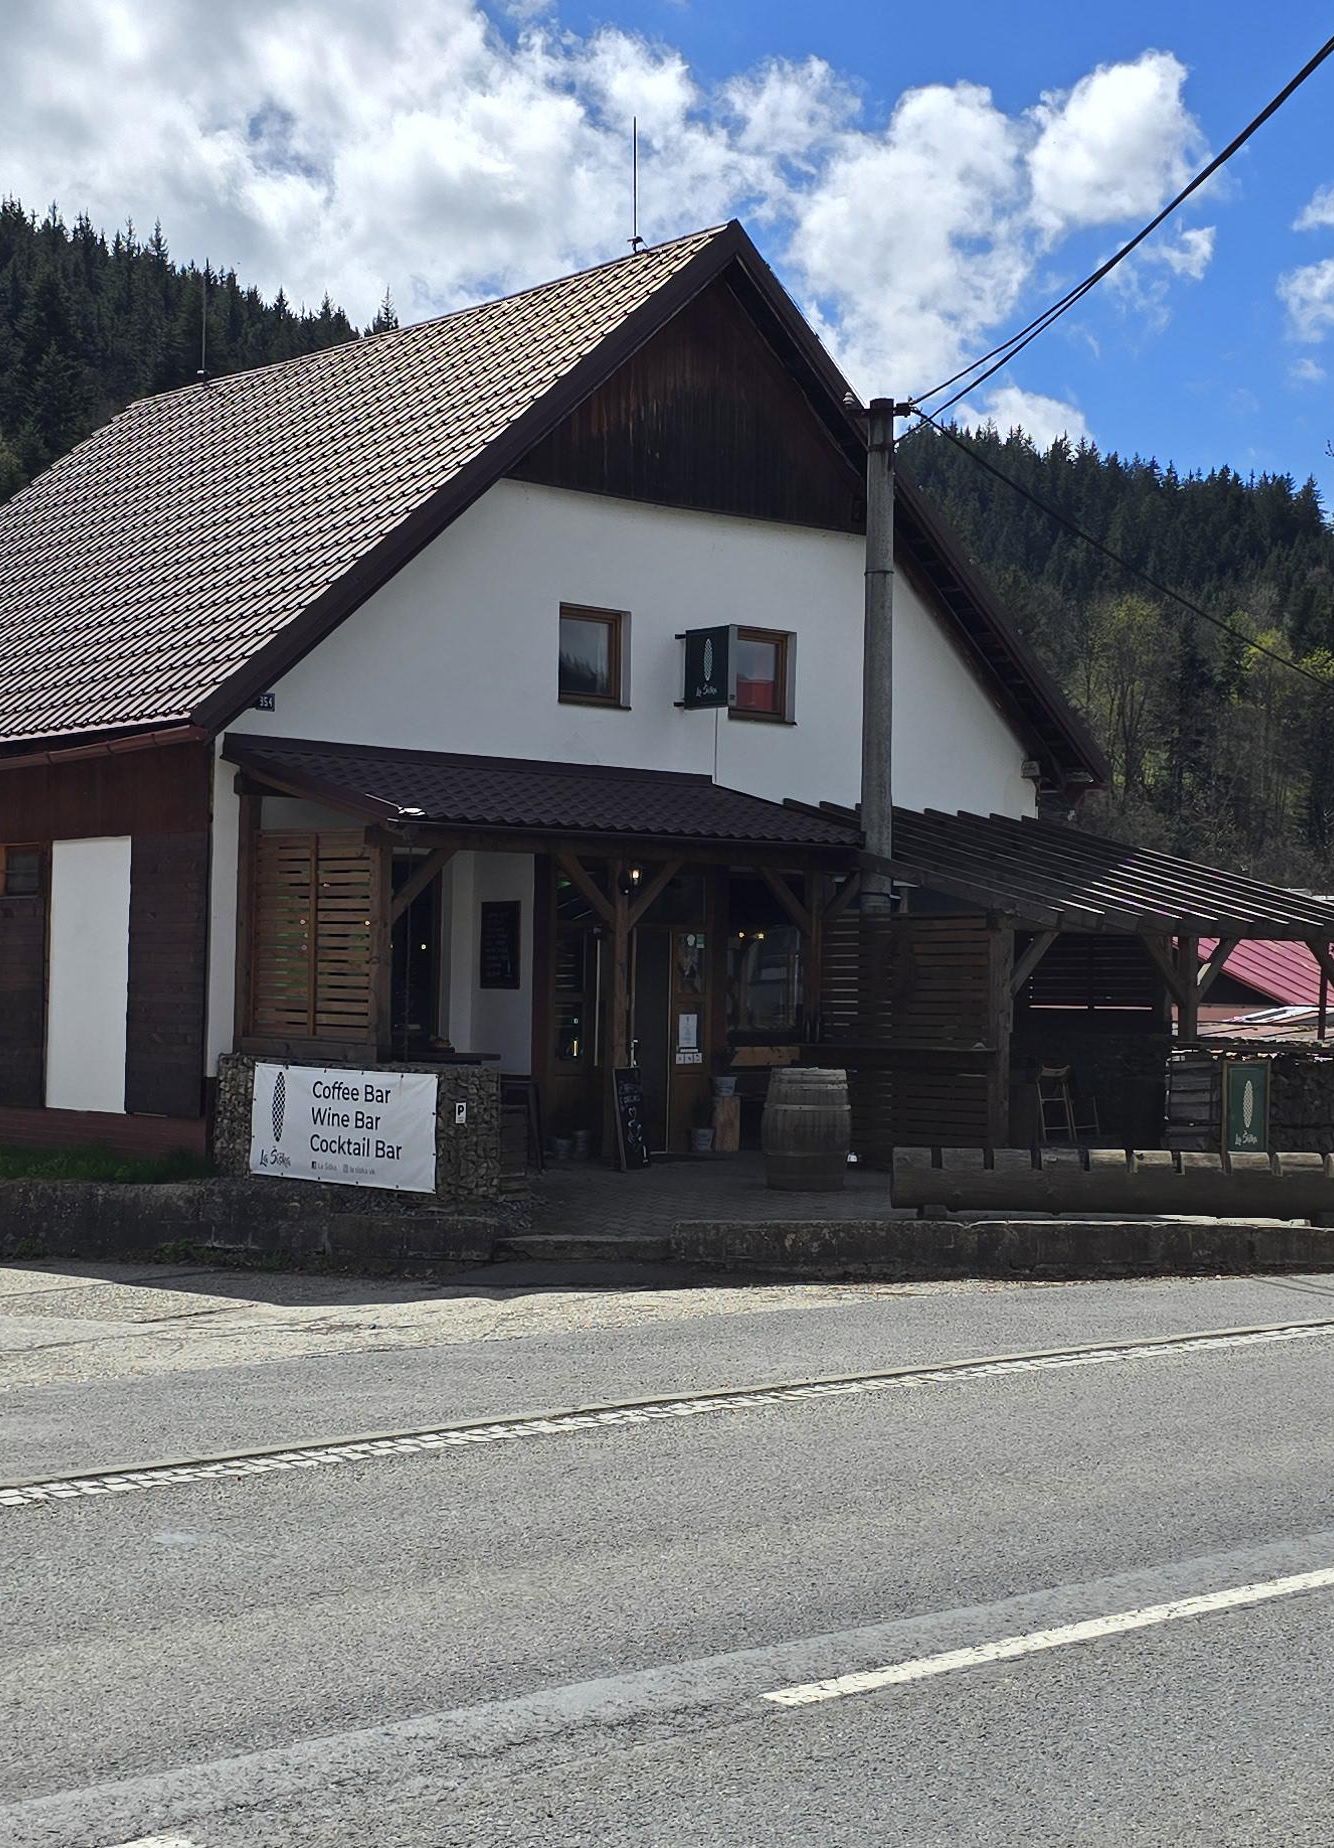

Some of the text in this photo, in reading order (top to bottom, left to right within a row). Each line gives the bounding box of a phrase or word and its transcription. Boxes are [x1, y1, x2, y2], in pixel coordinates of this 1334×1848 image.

[312, 1081, 391, 1104] Coffee Bar
[311, 1107, 381, 1131] Wine Bar
[458, 1105, 464, 1115] P
[259, 1149, 268, 1168] La
[310, 1134, 402, 1160] Cocktail Bar
